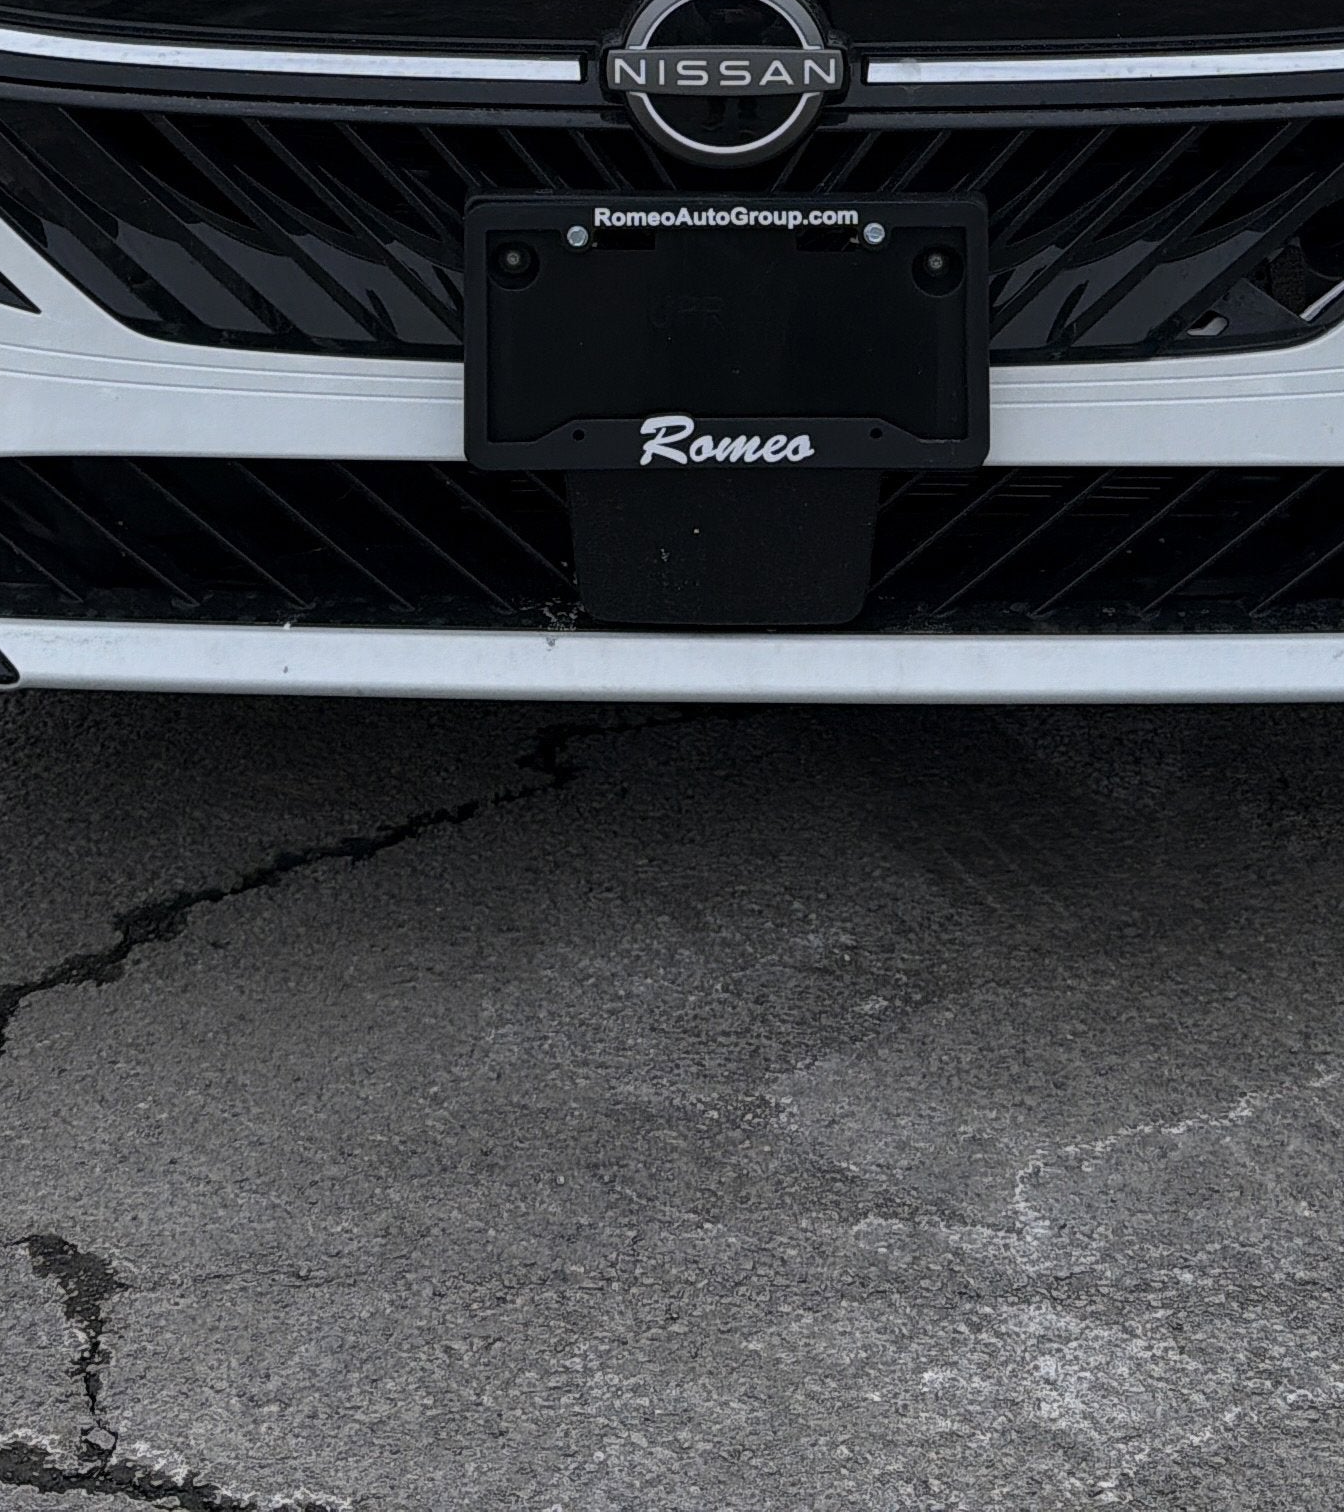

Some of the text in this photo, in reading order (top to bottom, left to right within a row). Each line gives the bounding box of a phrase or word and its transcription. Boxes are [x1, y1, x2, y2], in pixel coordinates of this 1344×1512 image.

[614, 58, 835, 86] NISSAN
[594, 207, 858, 229] RomeoAutoGroup.com
[639, 415, 815, 466] Romeo
